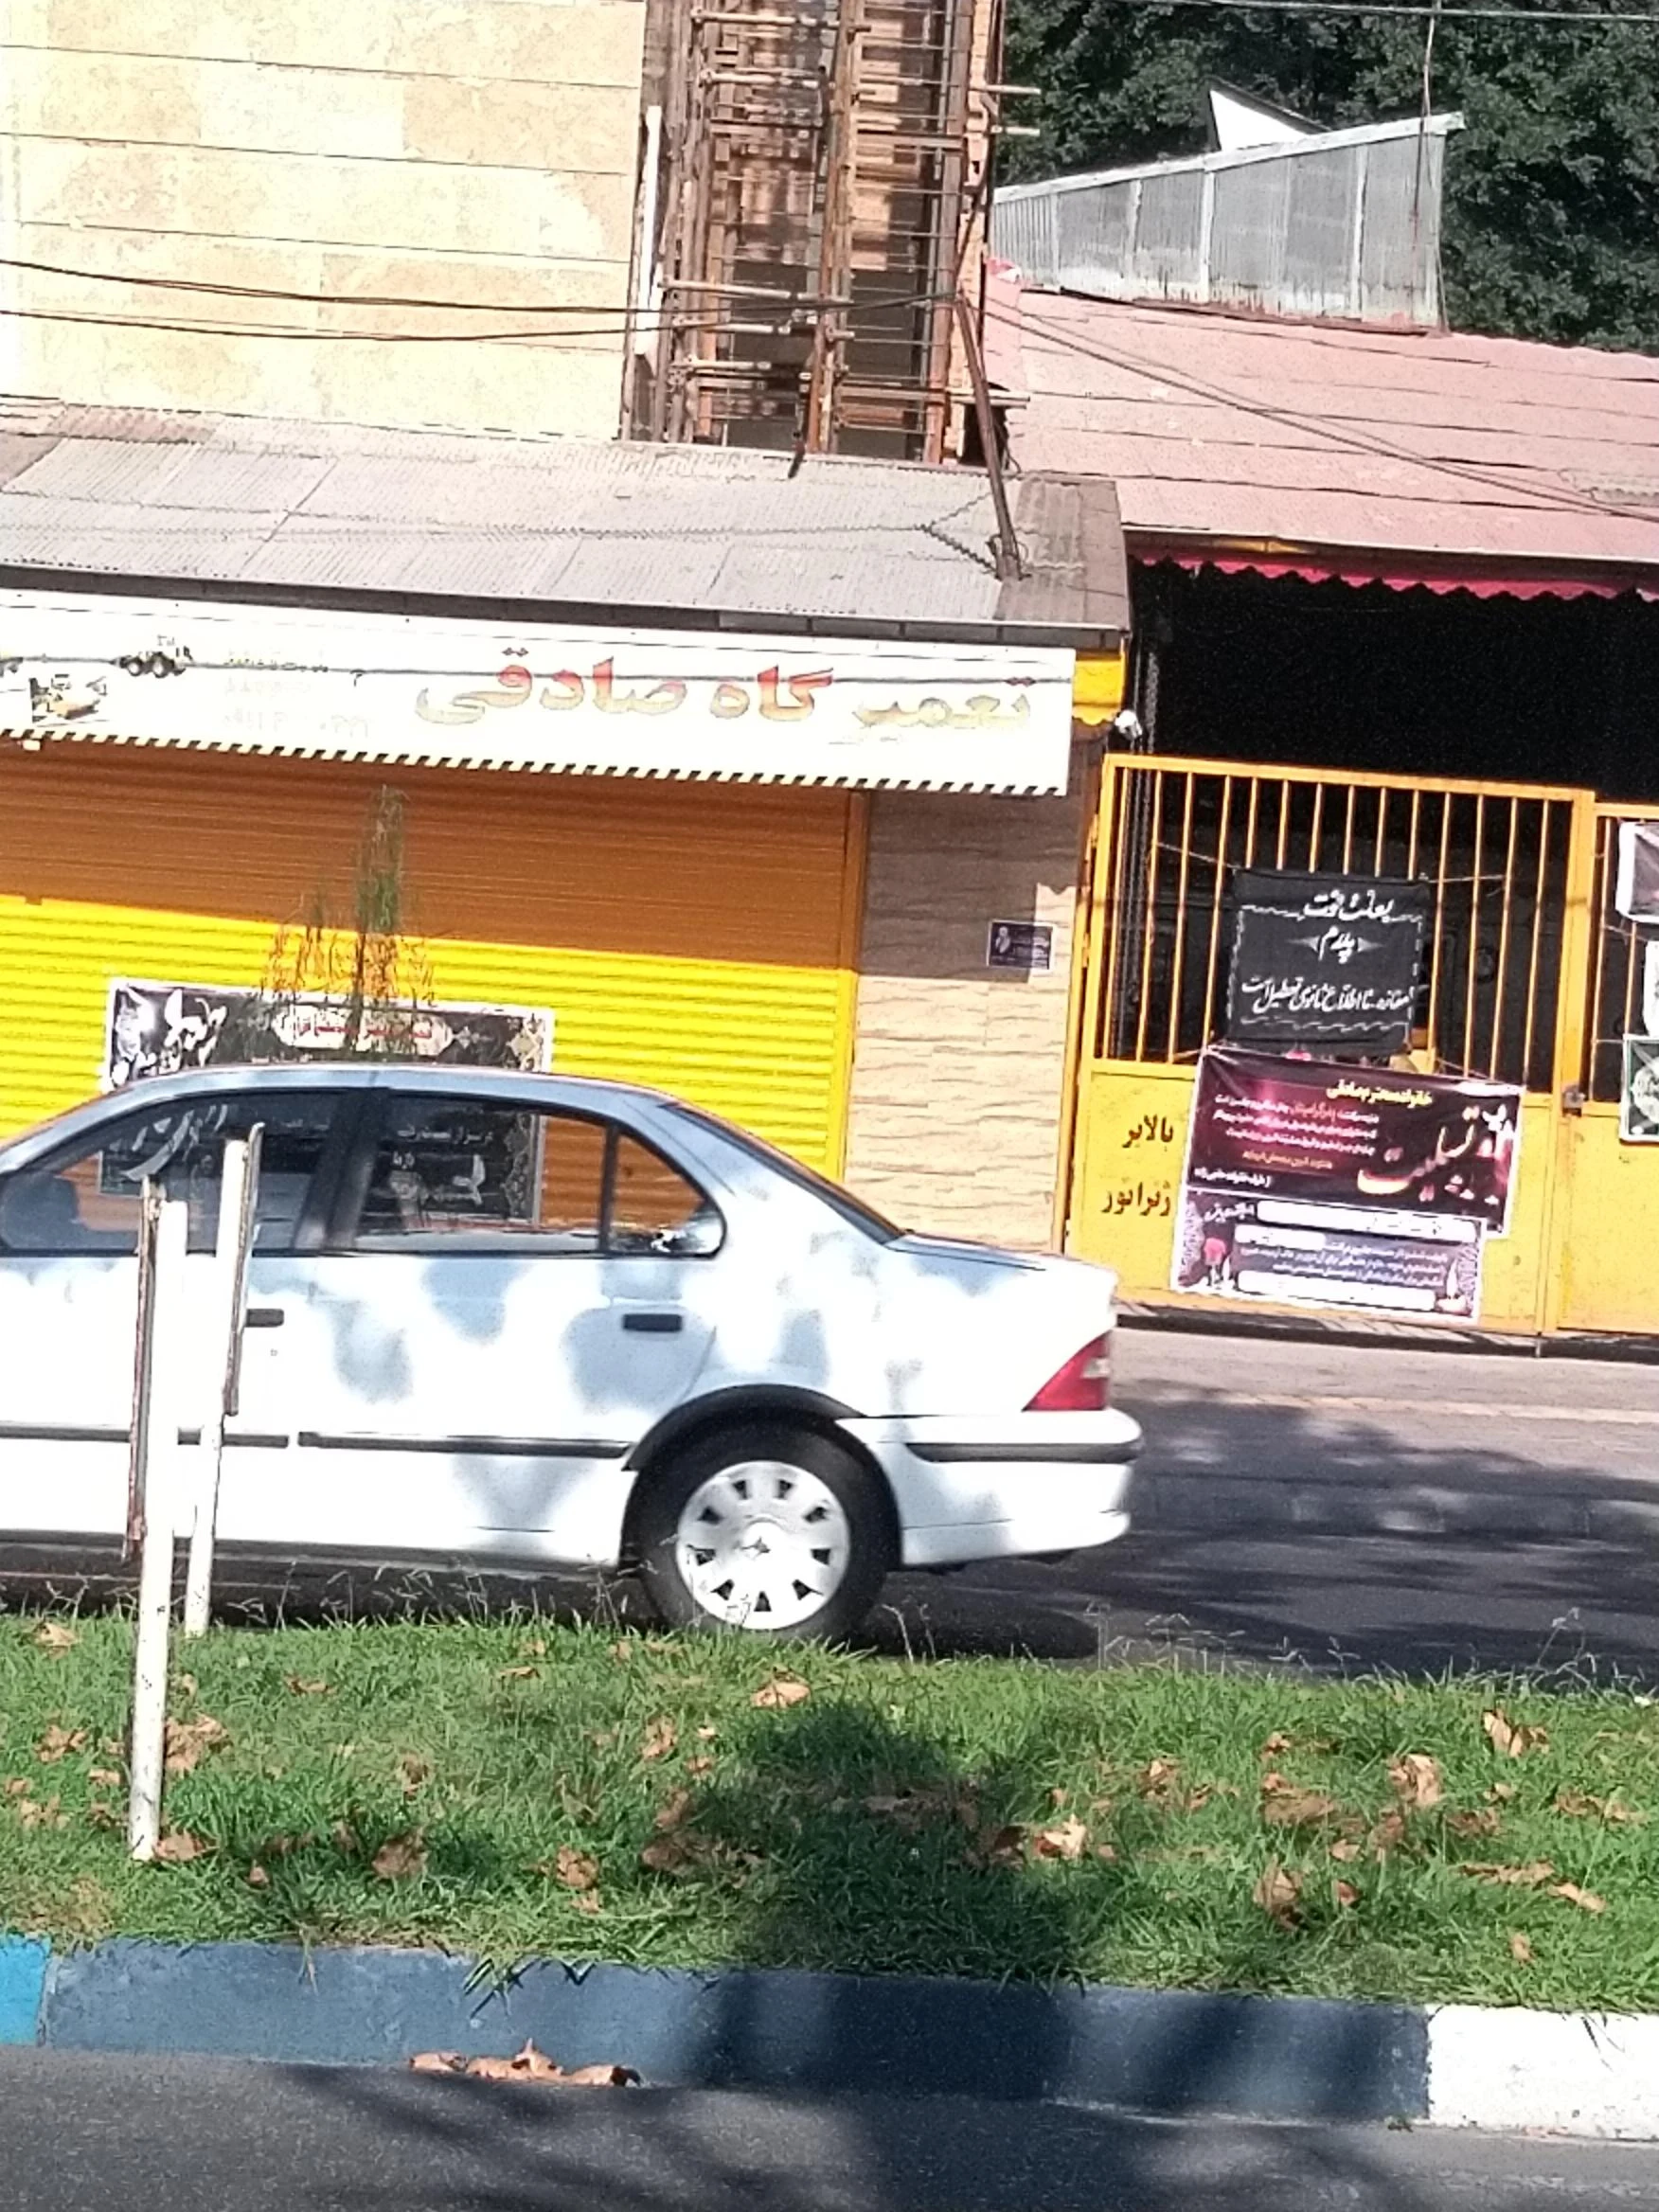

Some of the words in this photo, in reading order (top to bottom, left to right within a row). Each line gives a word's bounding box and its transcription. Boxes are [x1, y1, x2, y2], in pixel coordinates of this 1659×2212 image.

[415, 647, 689, 725] صادقی
[1302, 887, 1345, 919] فوت
[1356, 1103, 1481, 1203] تسلیت
